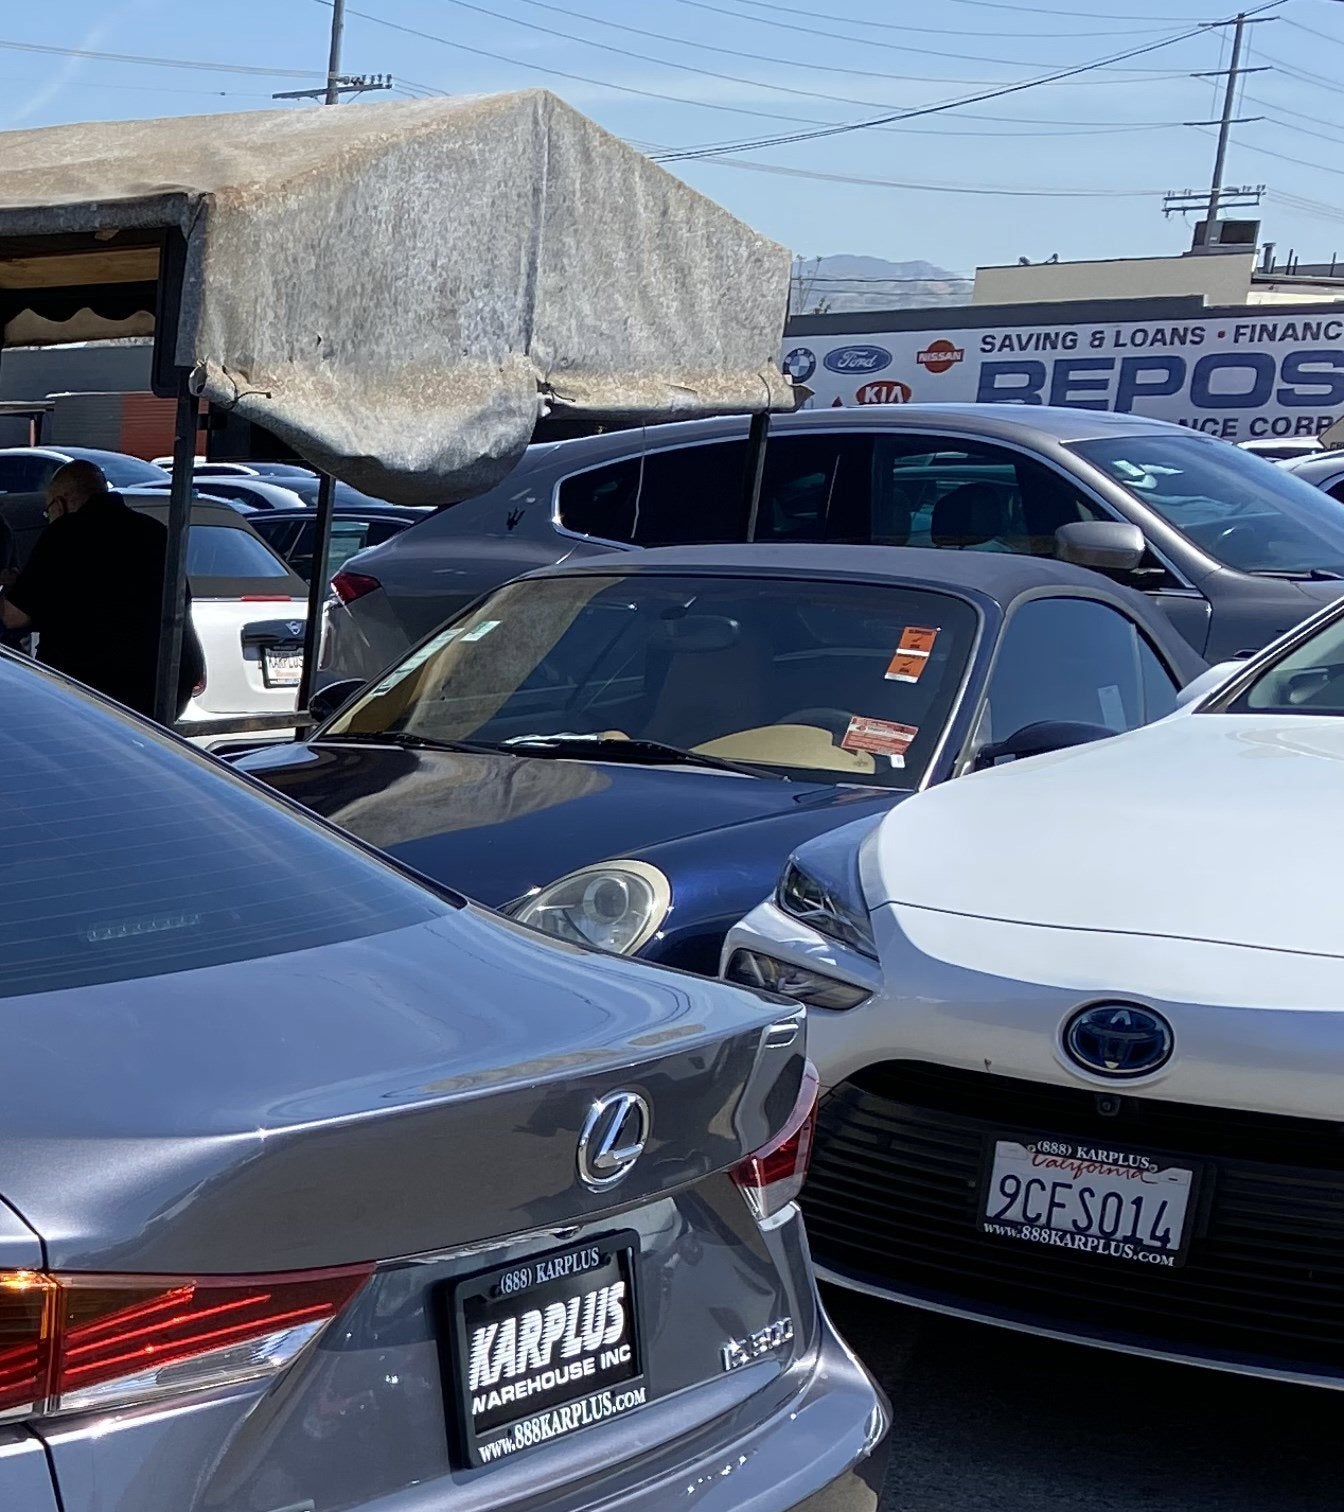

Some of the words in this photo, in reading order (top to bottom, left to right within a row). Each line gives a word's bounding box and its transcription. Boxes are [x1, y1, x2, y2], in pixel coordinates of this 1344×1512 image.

[980, 331, 1078, 354] SAVING
[1089, 330, 1106, 348] &
[1113, 326, 1206, 348] LOANS
[837, 349, 877, 368] Ford
[918, 351, 962, 363] NISSAN
[864, 385, 904, 404] KIA
[1037, 1140, 1073, 1157] (888)
[1076, 1146, 1151, 1169] KARPLUS
[1031, 1153, 1159, 1185] California
[993, 1174, 1172, 1249] 9CFS014
[500, 1267, 533, 1294] (888)
[535, 1247, 600, 1284] KARPLUS
[469, 1281, 625, 1391] KARPLUS
[600, 1344, 632, 1370] INC
